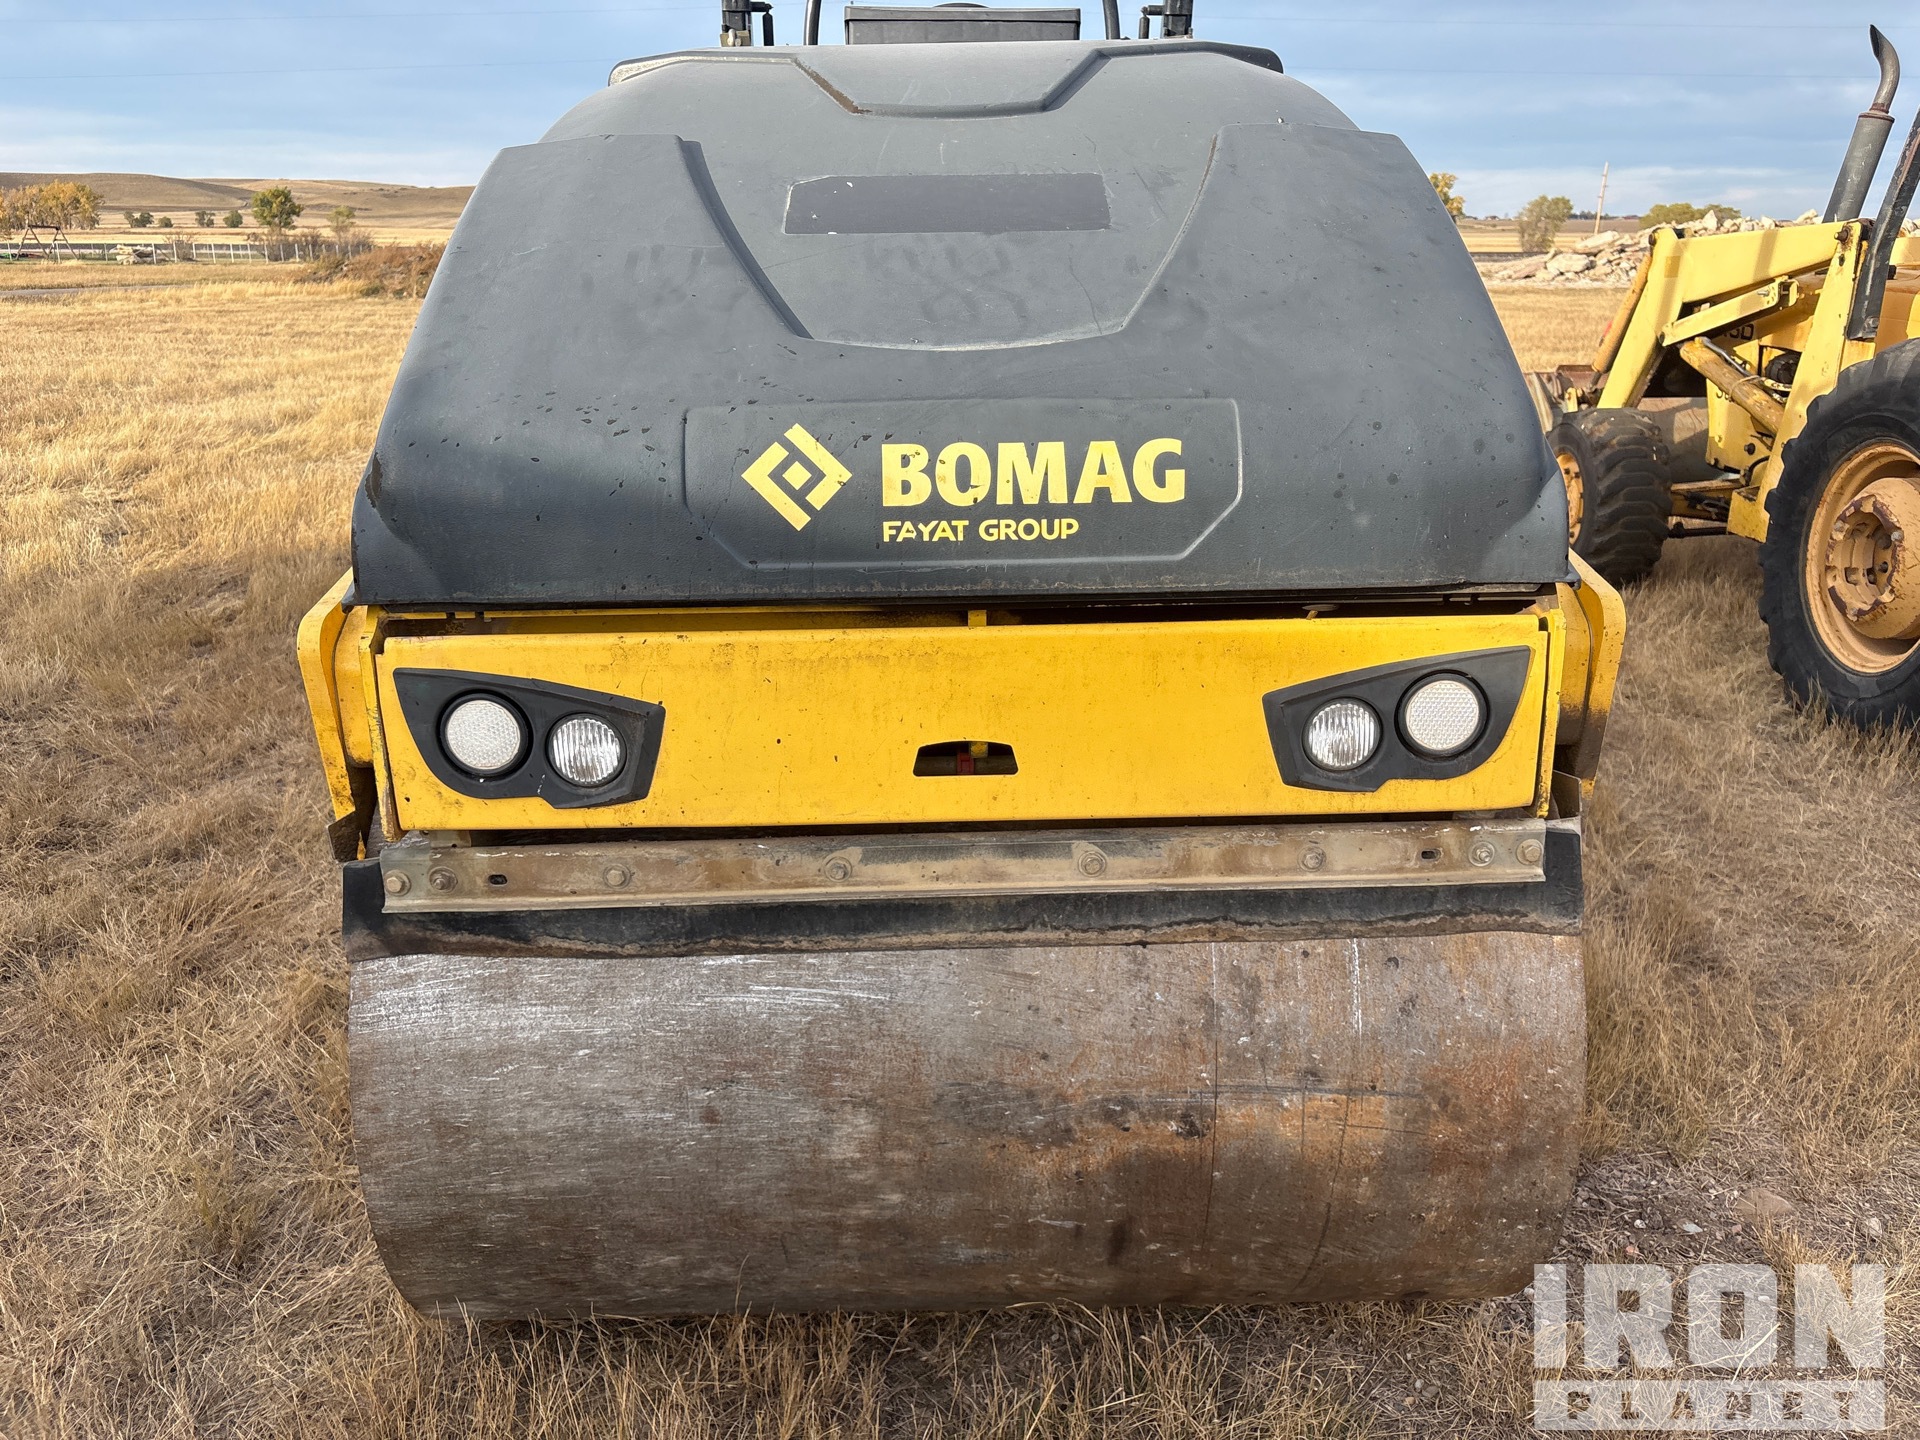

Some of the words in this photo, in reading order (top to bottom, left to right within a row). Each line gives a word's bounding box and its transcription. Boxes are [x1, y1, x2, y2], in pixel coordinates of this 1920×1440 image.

[882, 438, 1185, 507] BOMAG
[883, 520, 969, 542] FAYAT
[979, 518, 1079, 541] GROUP
